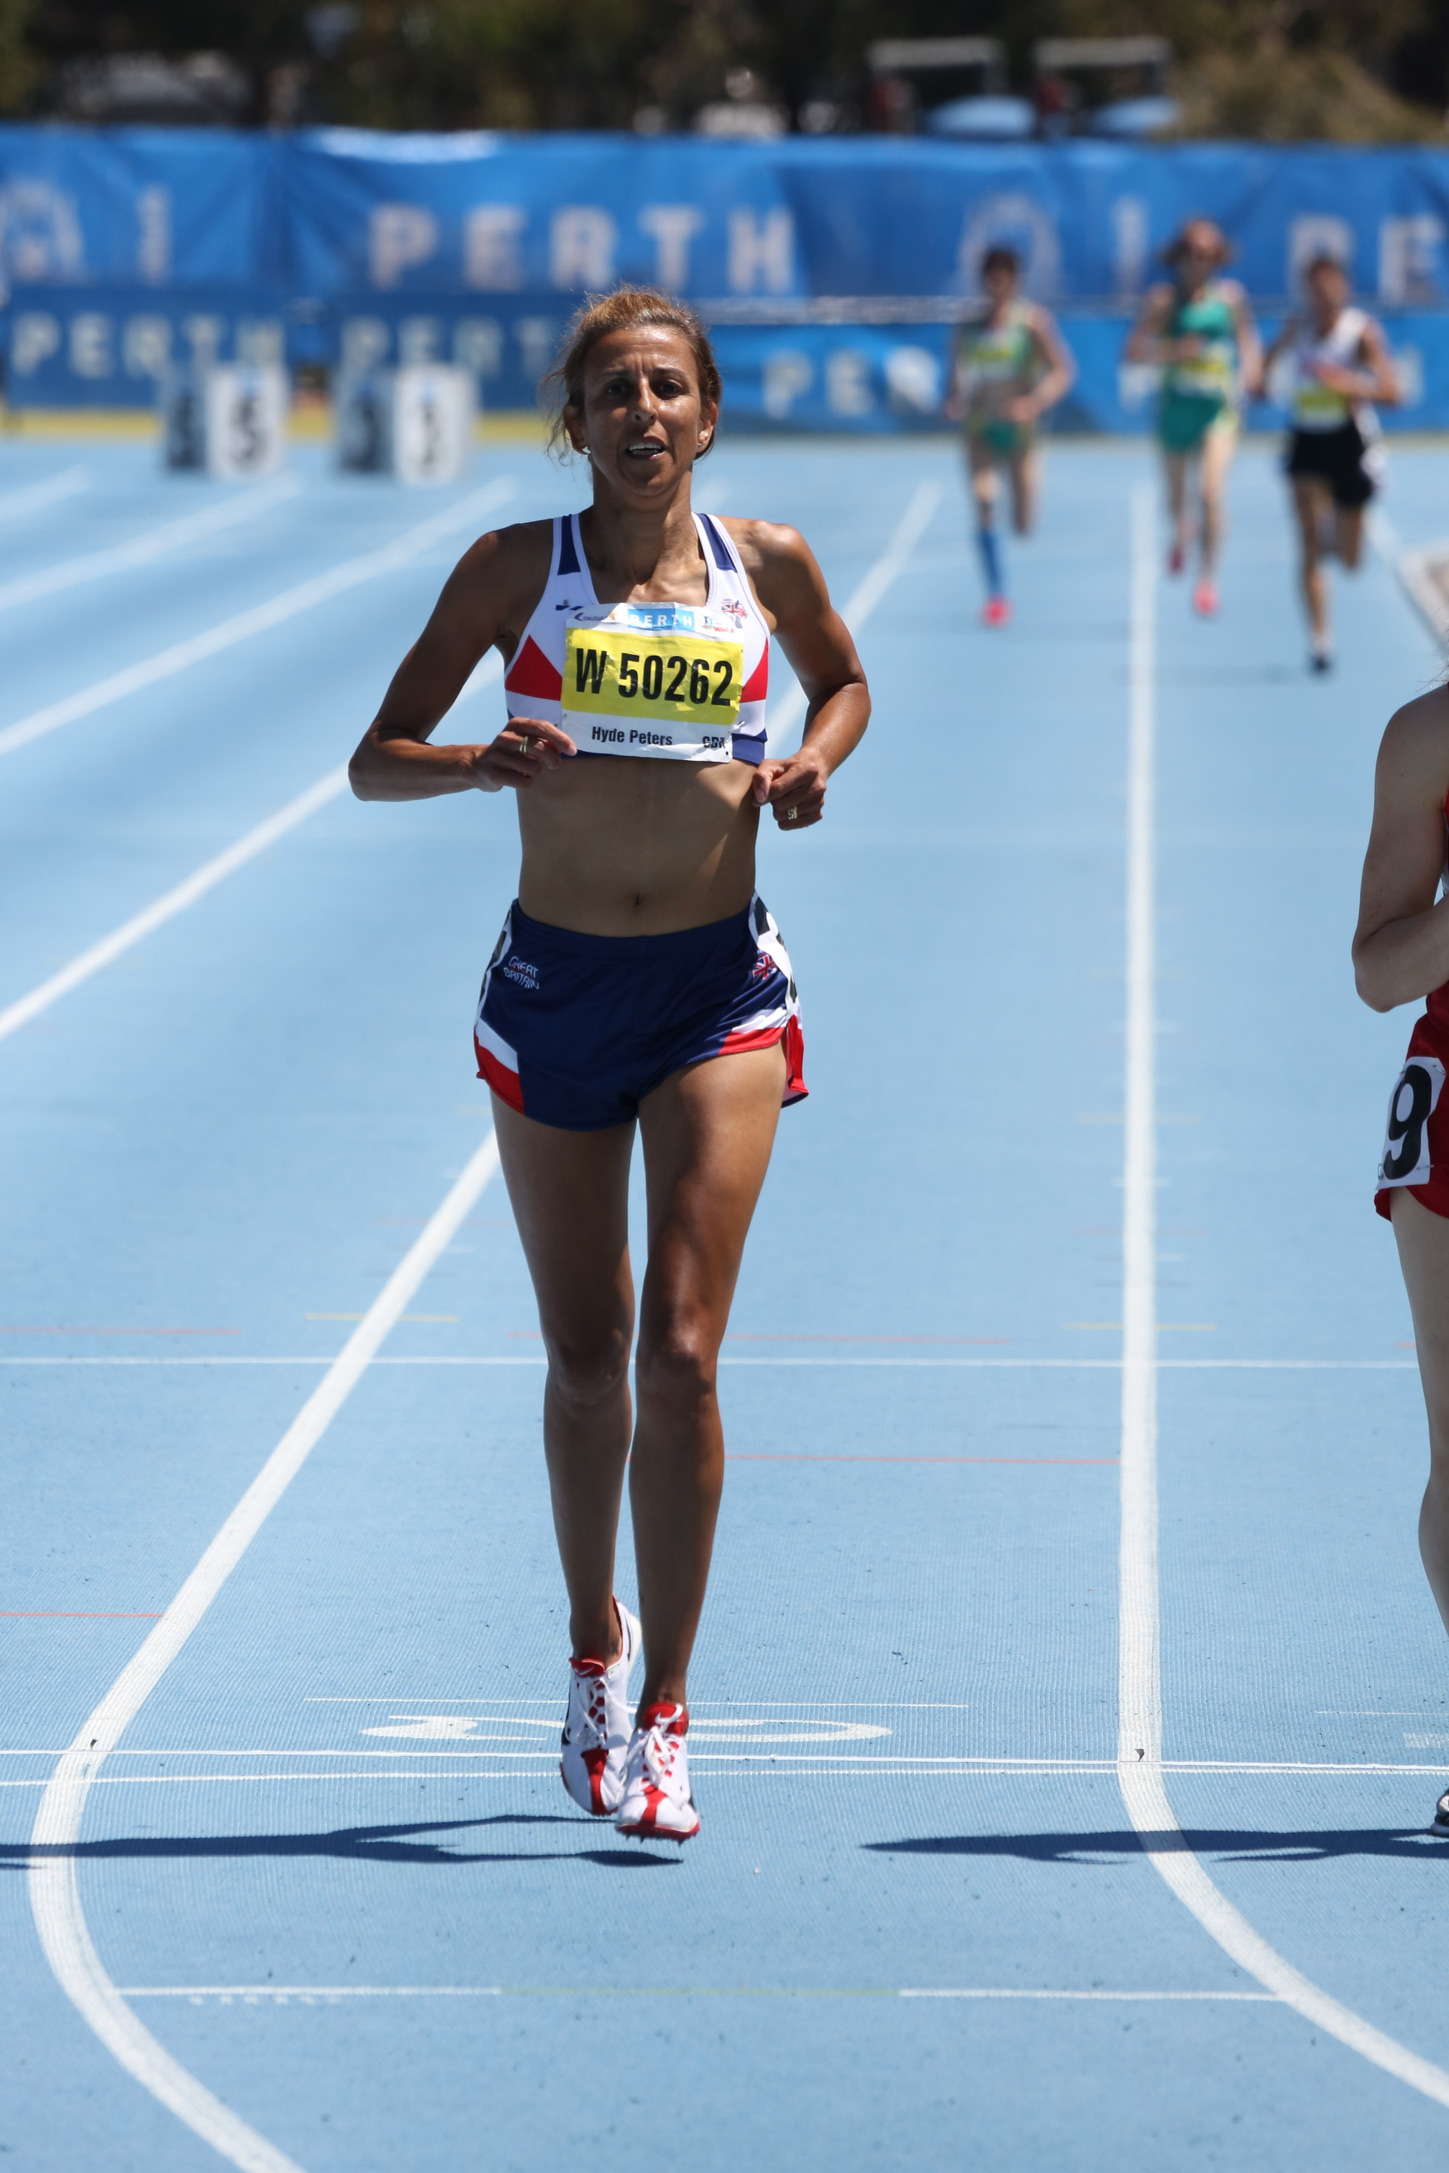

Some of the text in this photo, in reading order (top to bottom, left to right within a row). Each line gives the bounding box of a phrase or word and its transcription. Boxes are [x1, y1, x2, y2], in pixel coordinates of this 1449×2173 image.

[366, 203, 796, 293] PERTH
[10, 312, 285, 380] PERTH
[342, 315, 556, 380] PERT
[628, 613, 693, 628] PERTH
[576, 648, 734, 707] W 50262
[591, 726, 625, 743] Hyde
[629, 729, 673, 746] Peters
[503, 967, 540, 990] BRITAIN
[508, 956, 539, 978] GREAT
[1383, 1064, 1433, 1181] 9
